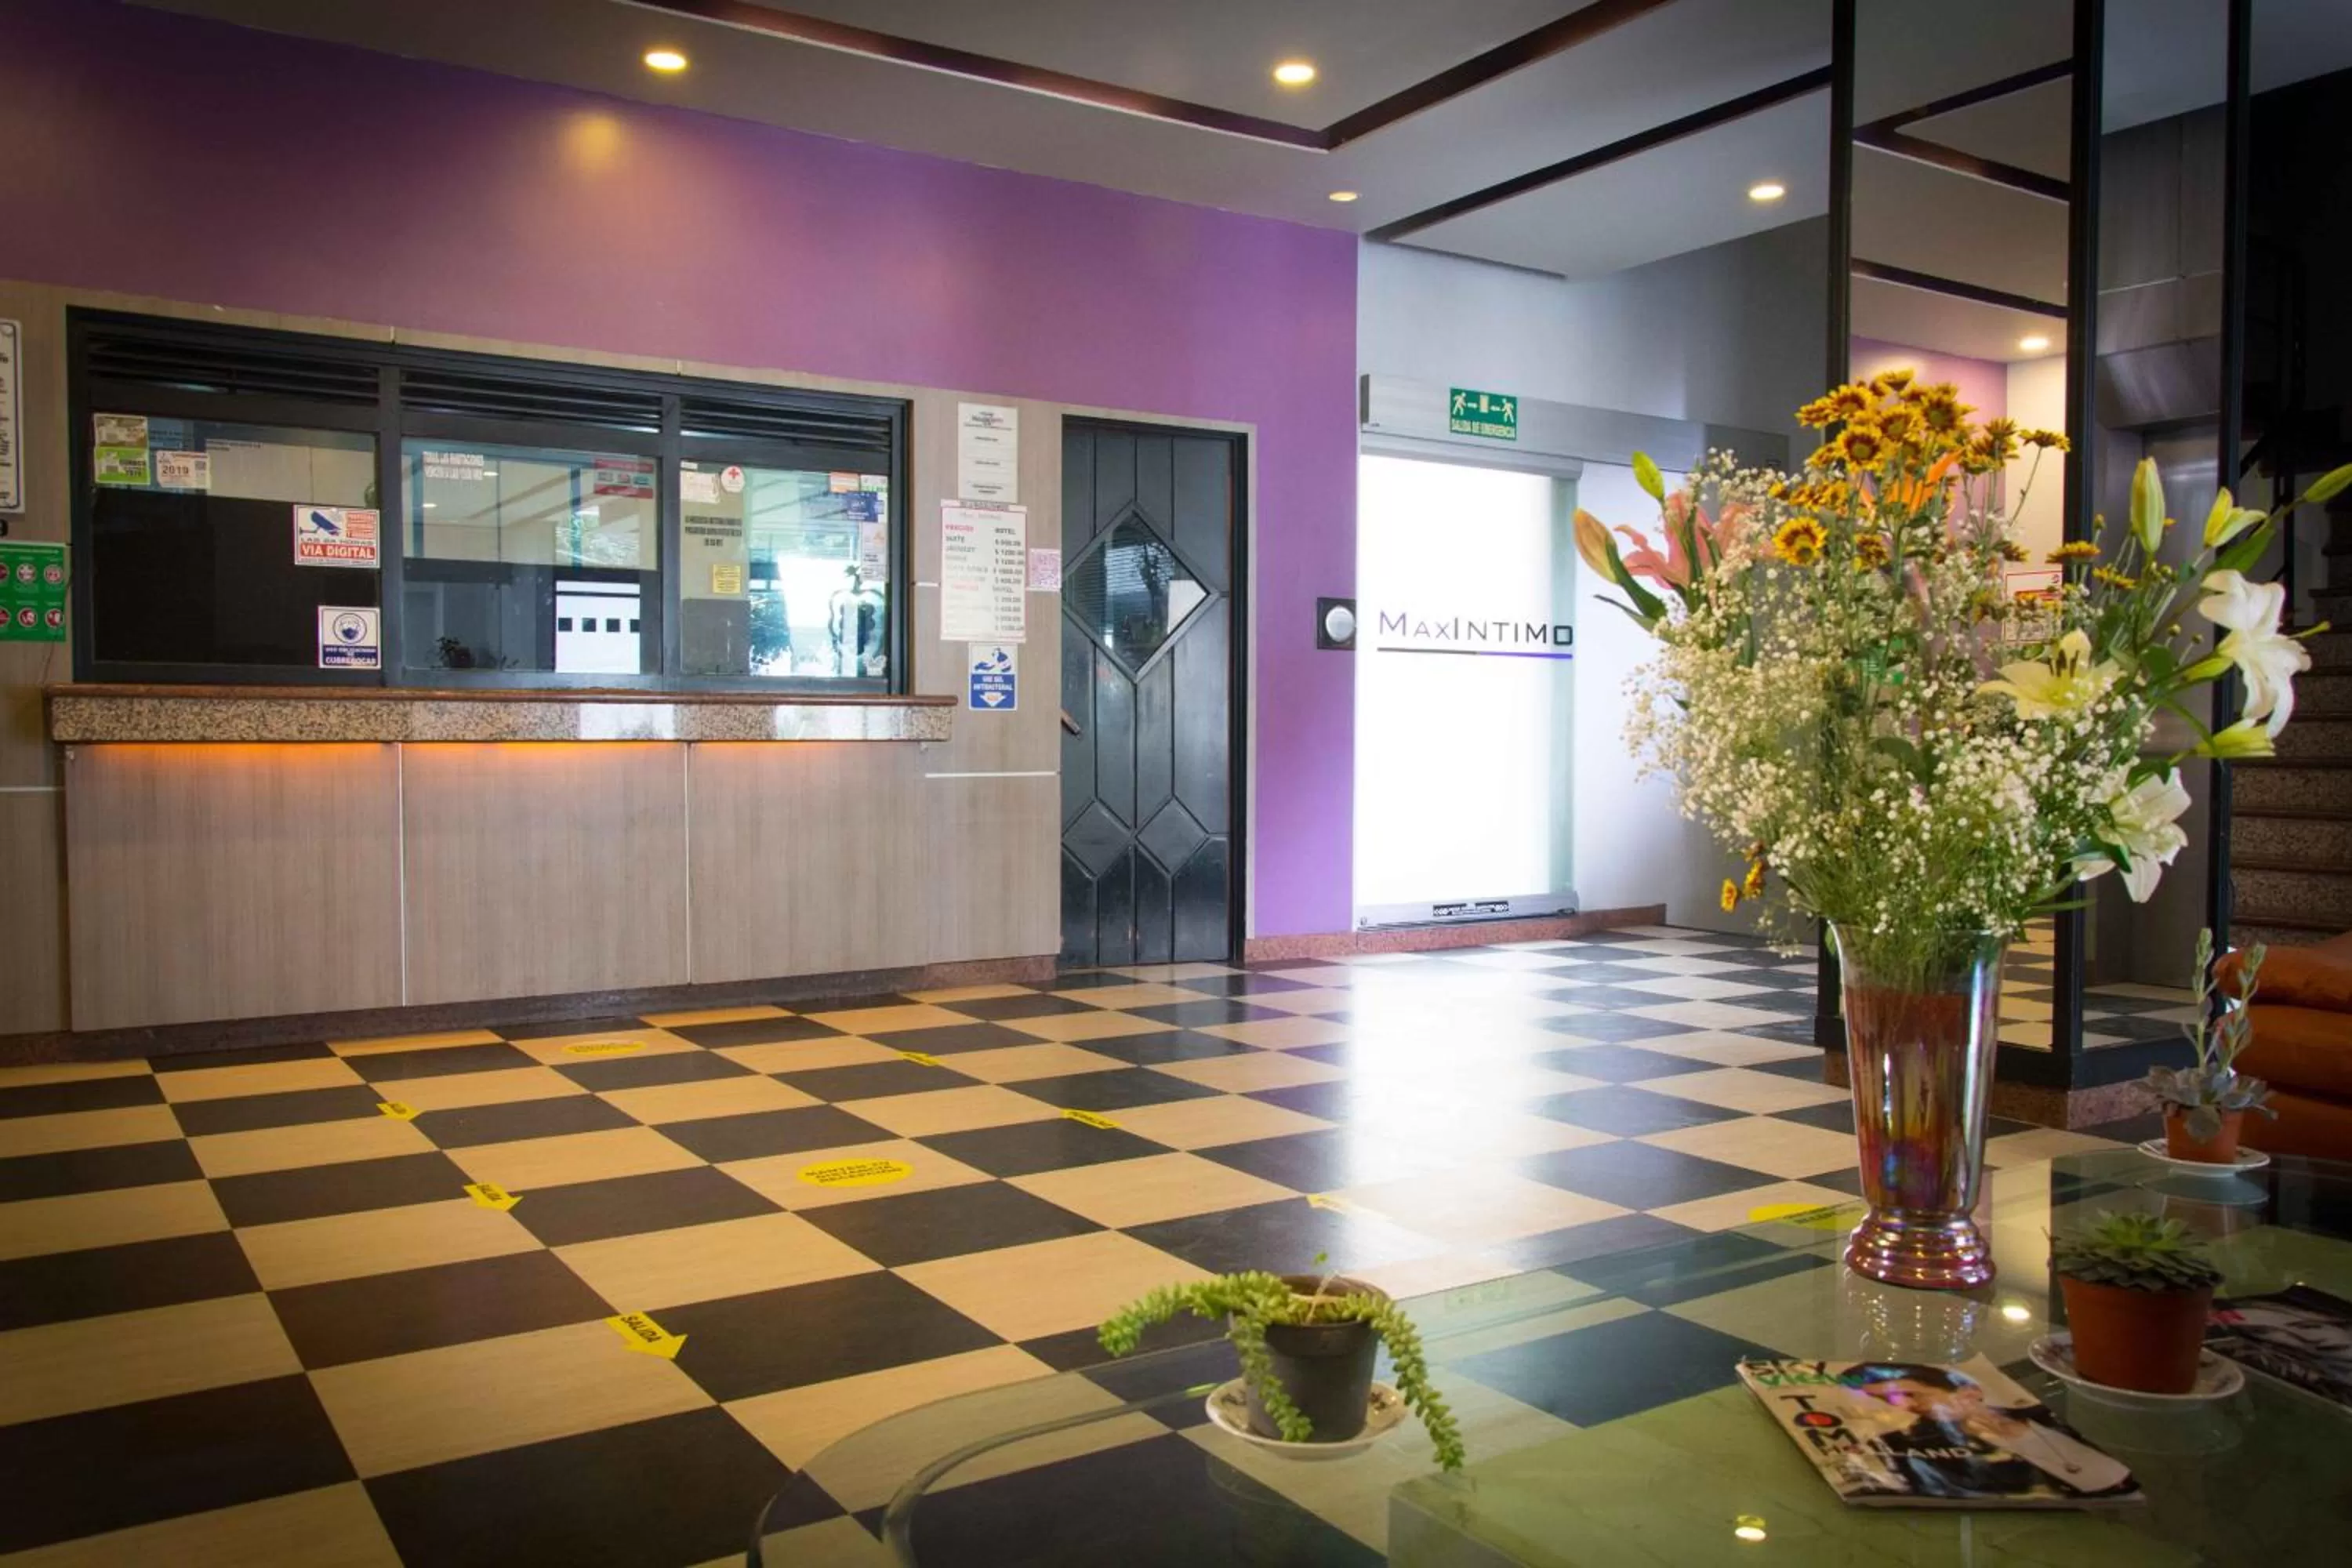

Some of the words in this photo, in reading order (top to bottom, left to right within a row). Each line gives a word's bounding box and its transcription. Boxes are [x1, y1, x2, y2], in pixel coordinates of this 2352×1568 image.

[301, 543, 324, 556] VIA
[326, 545, 375, 558] DIGITAL
[619, 1316, 662, 1343] SALIDA
